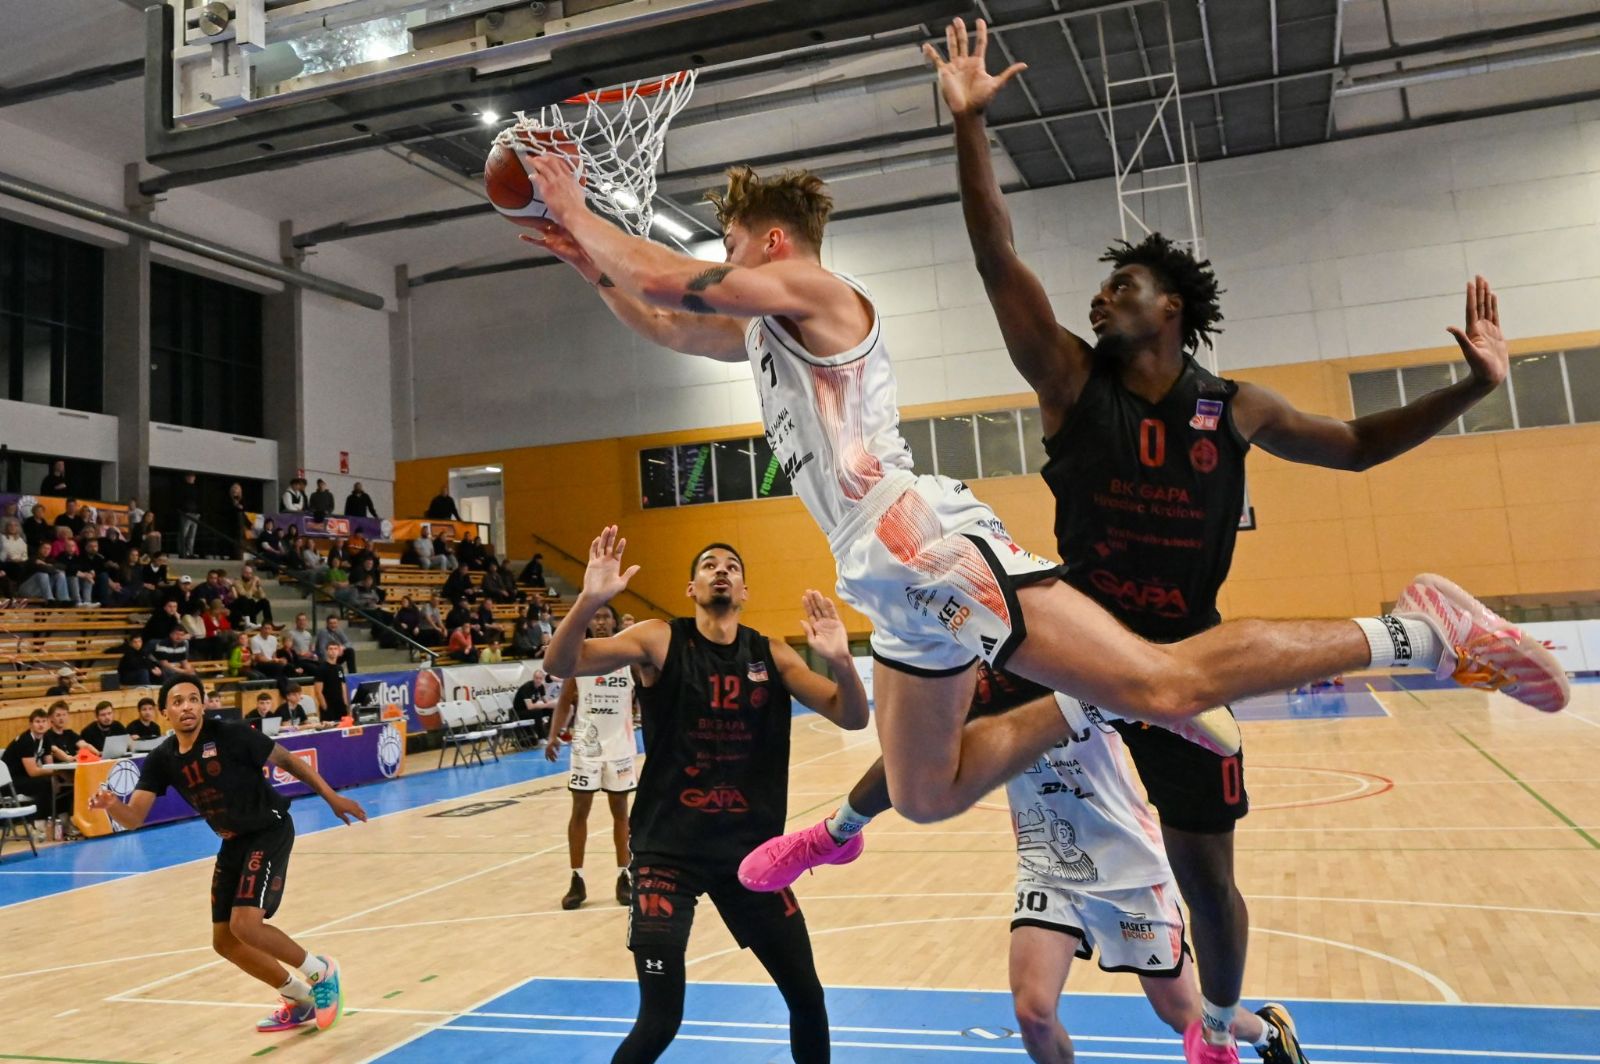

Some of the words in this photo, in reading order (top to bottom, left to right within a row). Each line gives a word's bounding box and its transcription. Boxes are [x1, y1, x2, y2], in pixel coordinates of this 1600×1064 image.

[761, 352, 778, 388] 7
[1140, 418, 1166, 467] 0
[1109, 479, 1134, 496] BK
[1139, 484, 1192, 504] GAPA
[1089, 569, 1189, 614] GAPA
[938, 596, 961, 624] KET
[949, 606, 971, 635] HOD
[608, 676, 628, 693] 25
[709, 674, 740, 709] 12
[590, 707, 616, 715] DHL
[181, 761, 205, 788] 11
[570, 773, 590, 787] 25
[1221, 757, 1241, 806] 0
[679, 787, 750, 811] GAPA
[236, 874, 257, 899] 11
[1014, 890, 1048, 913] 30
[1119, 920, 1152, 932] BASKET
